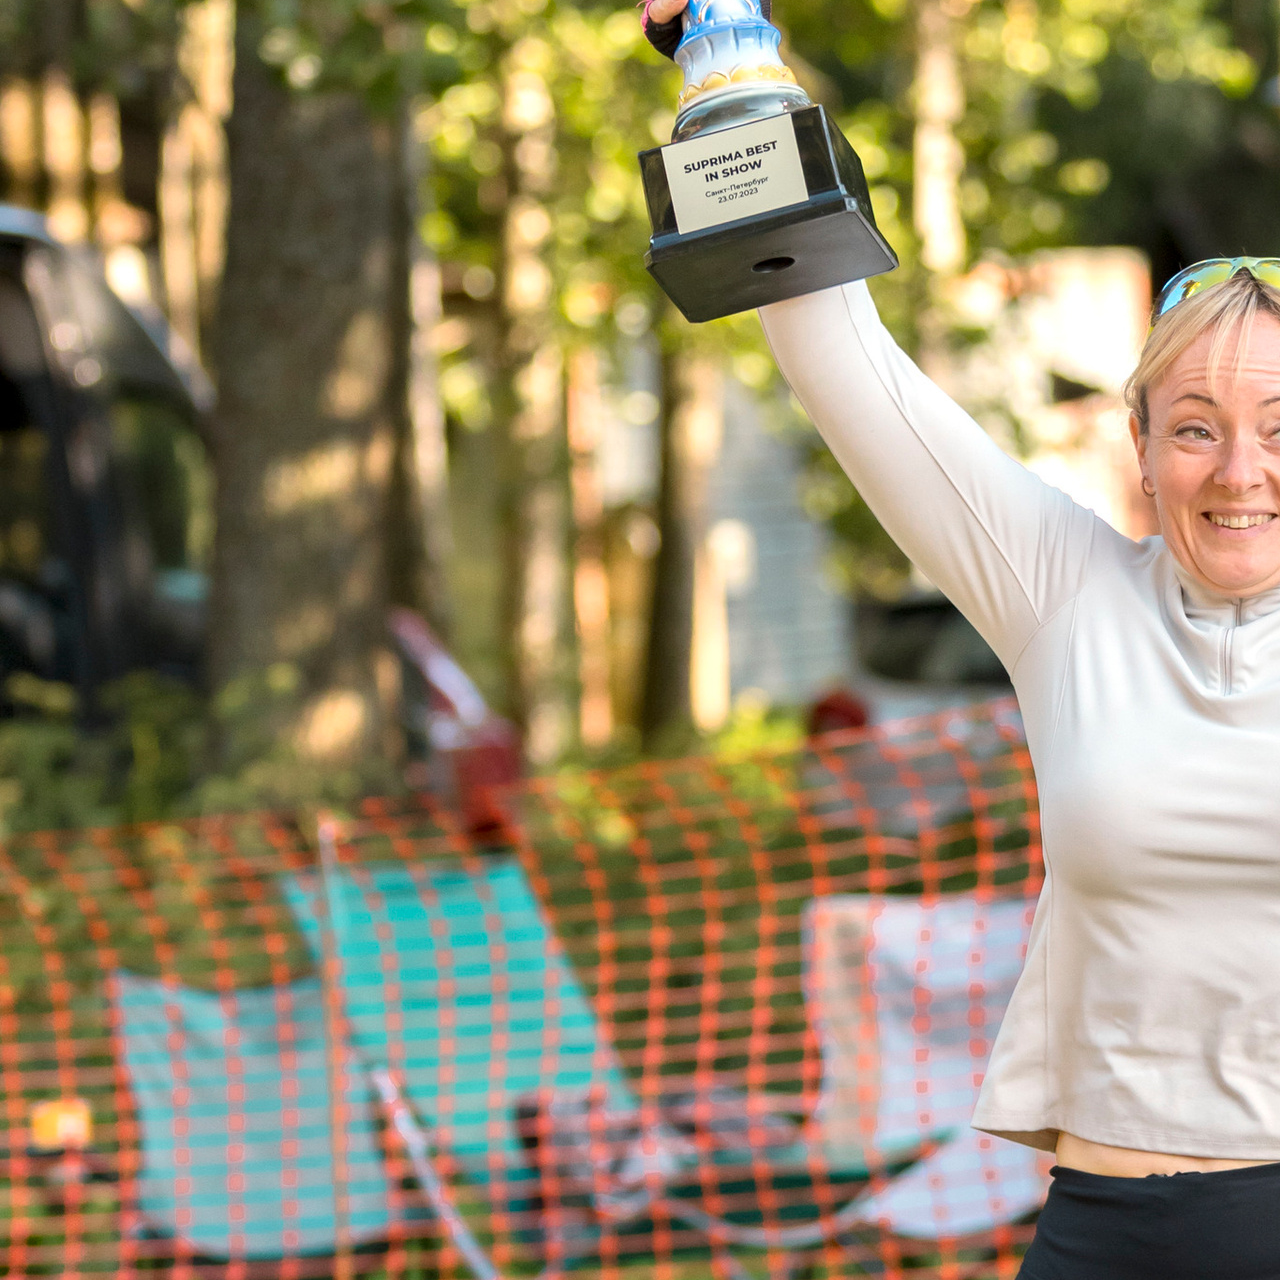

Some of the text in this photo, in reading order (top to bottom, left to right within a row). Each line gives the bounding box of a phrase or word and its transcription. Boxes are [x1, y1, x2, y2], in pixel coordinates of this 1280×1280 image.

[684, 140, 777, 174] SUPRIMA BEST
[704, 159, 762, 182] IN SHOW
[705, 176, 769, 198] Санкт-Петербург
[718, 187, 758, 203] 23.07.2023
